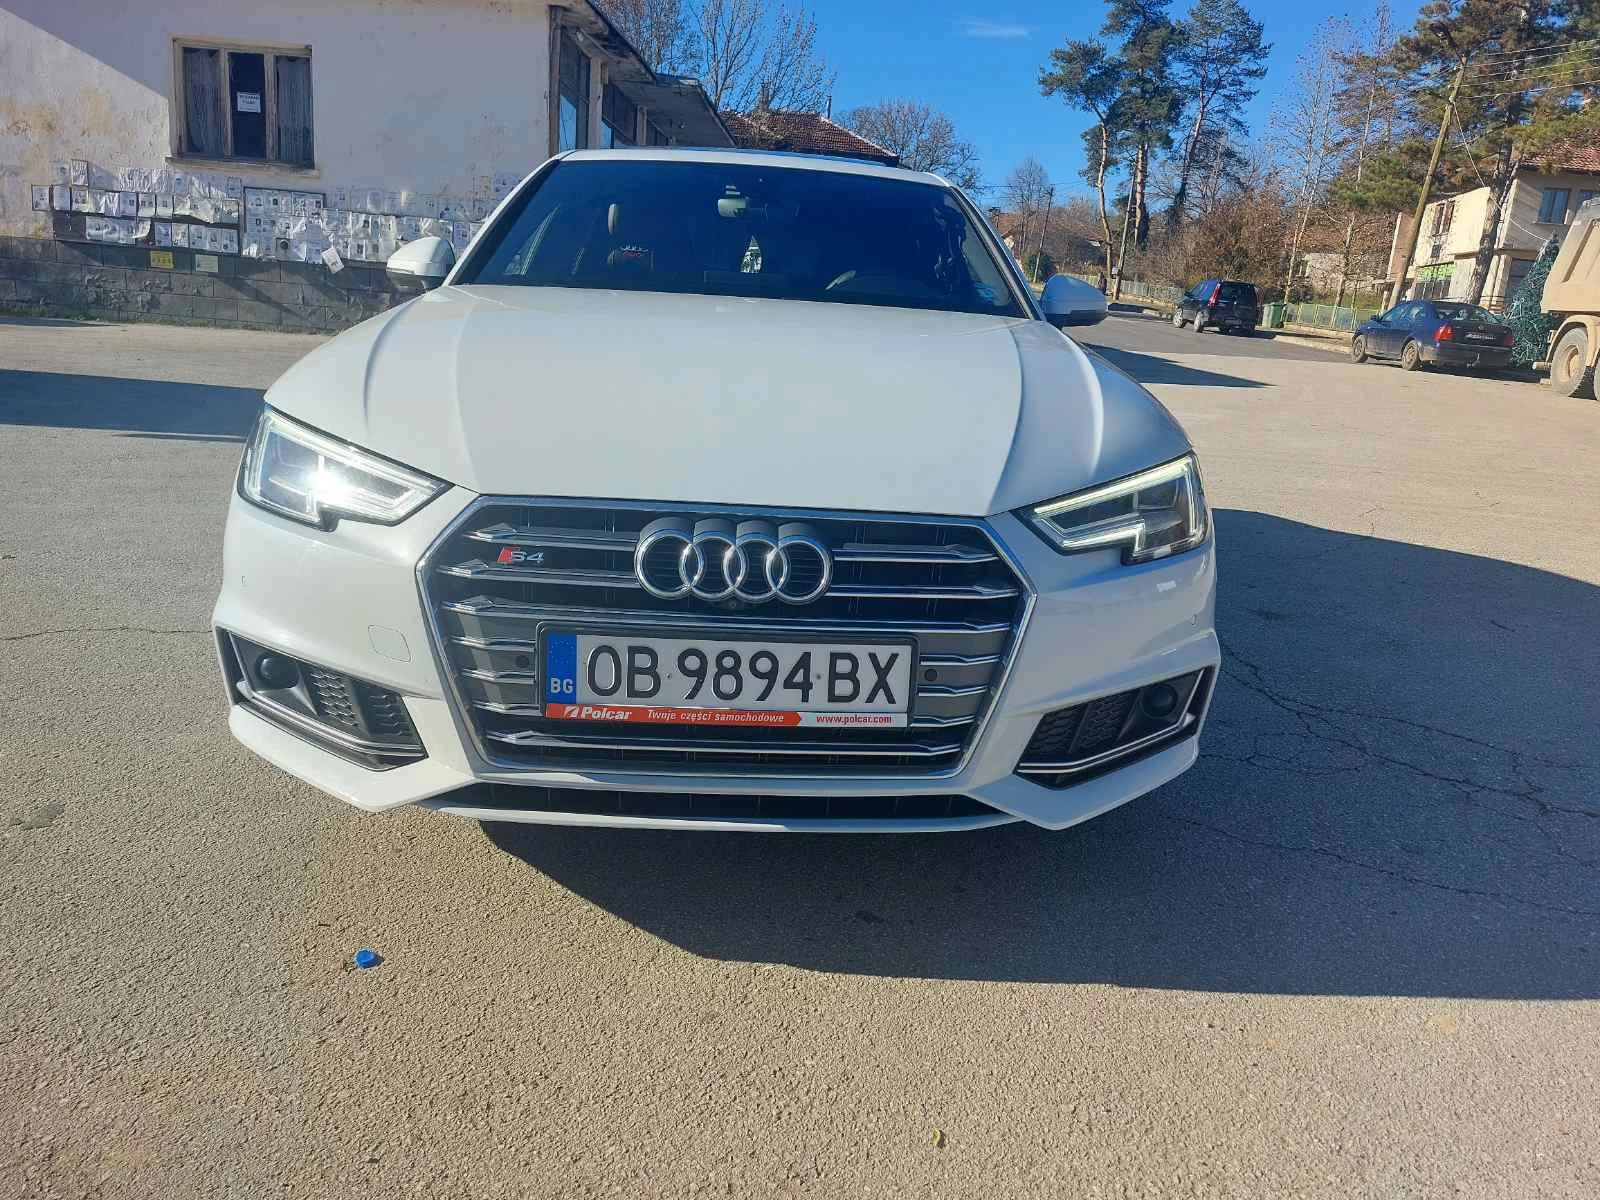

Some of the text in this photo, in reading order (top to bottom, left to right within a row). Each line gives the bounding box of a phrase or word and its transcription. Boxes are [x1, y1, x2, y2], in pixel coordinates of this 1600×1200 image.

[510, 551, 545, 563] S4
[586, 645, 899, 705] OB 9894 BX
[550, 677, 574, 693] BG
[581, 706, 632, 720] Polcar
[648, 710, 677, 721] Twoje
[714, 713, 785, 723] samochodowe
[816, 714, 893, 725] www.polcar.com
